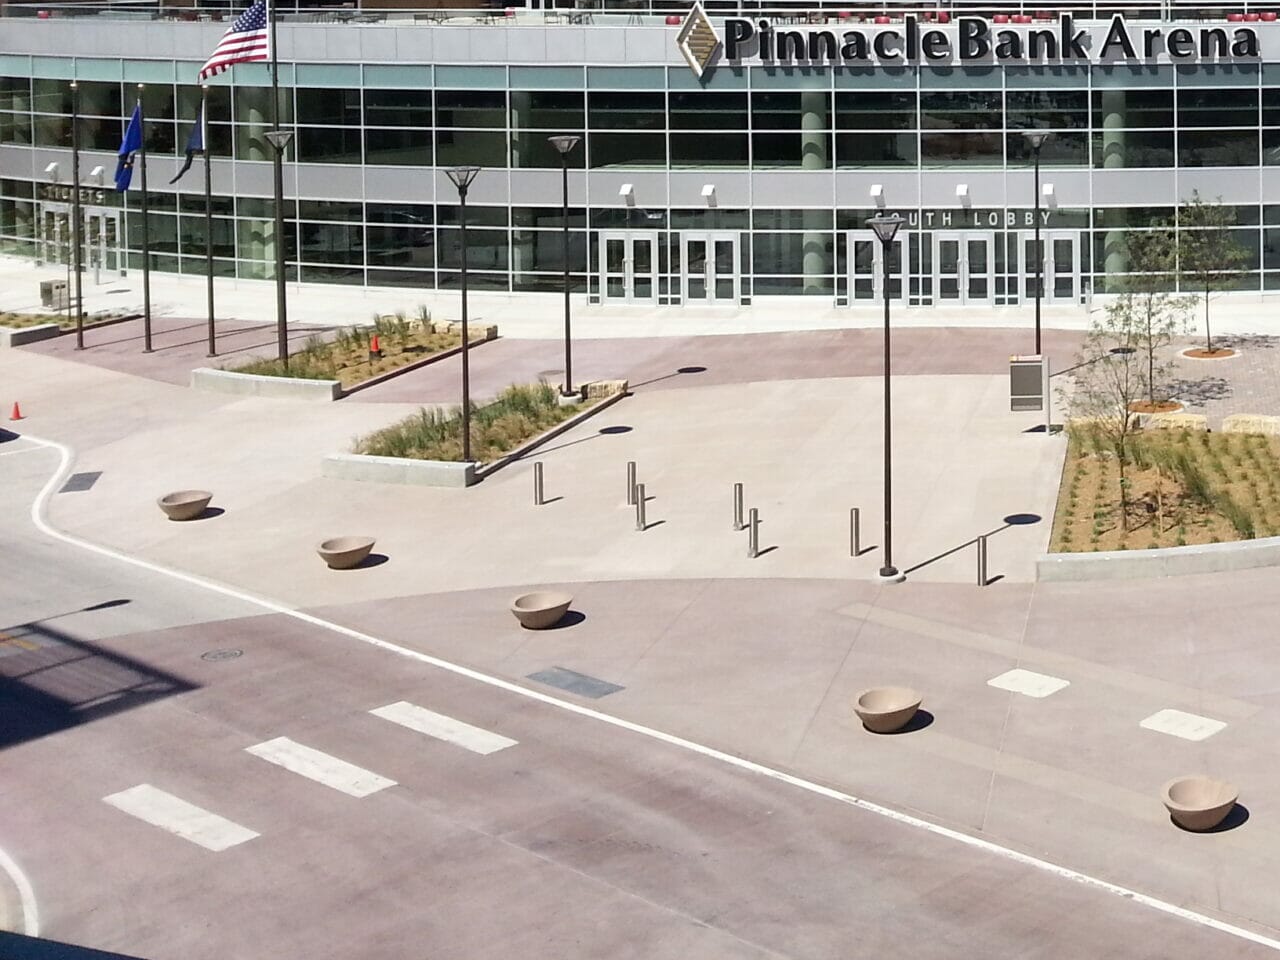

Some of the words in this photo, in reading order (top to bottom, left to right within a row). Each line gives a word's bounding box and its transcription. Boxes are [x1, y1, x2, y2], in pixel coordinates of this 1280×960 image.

[723, 13, 950, 61] Pinnacle
[957, 13, 1089, 60] Bank
[1100, 13, 1261, 59] Arena
[973, 211, 1051, 226] LOBBY
